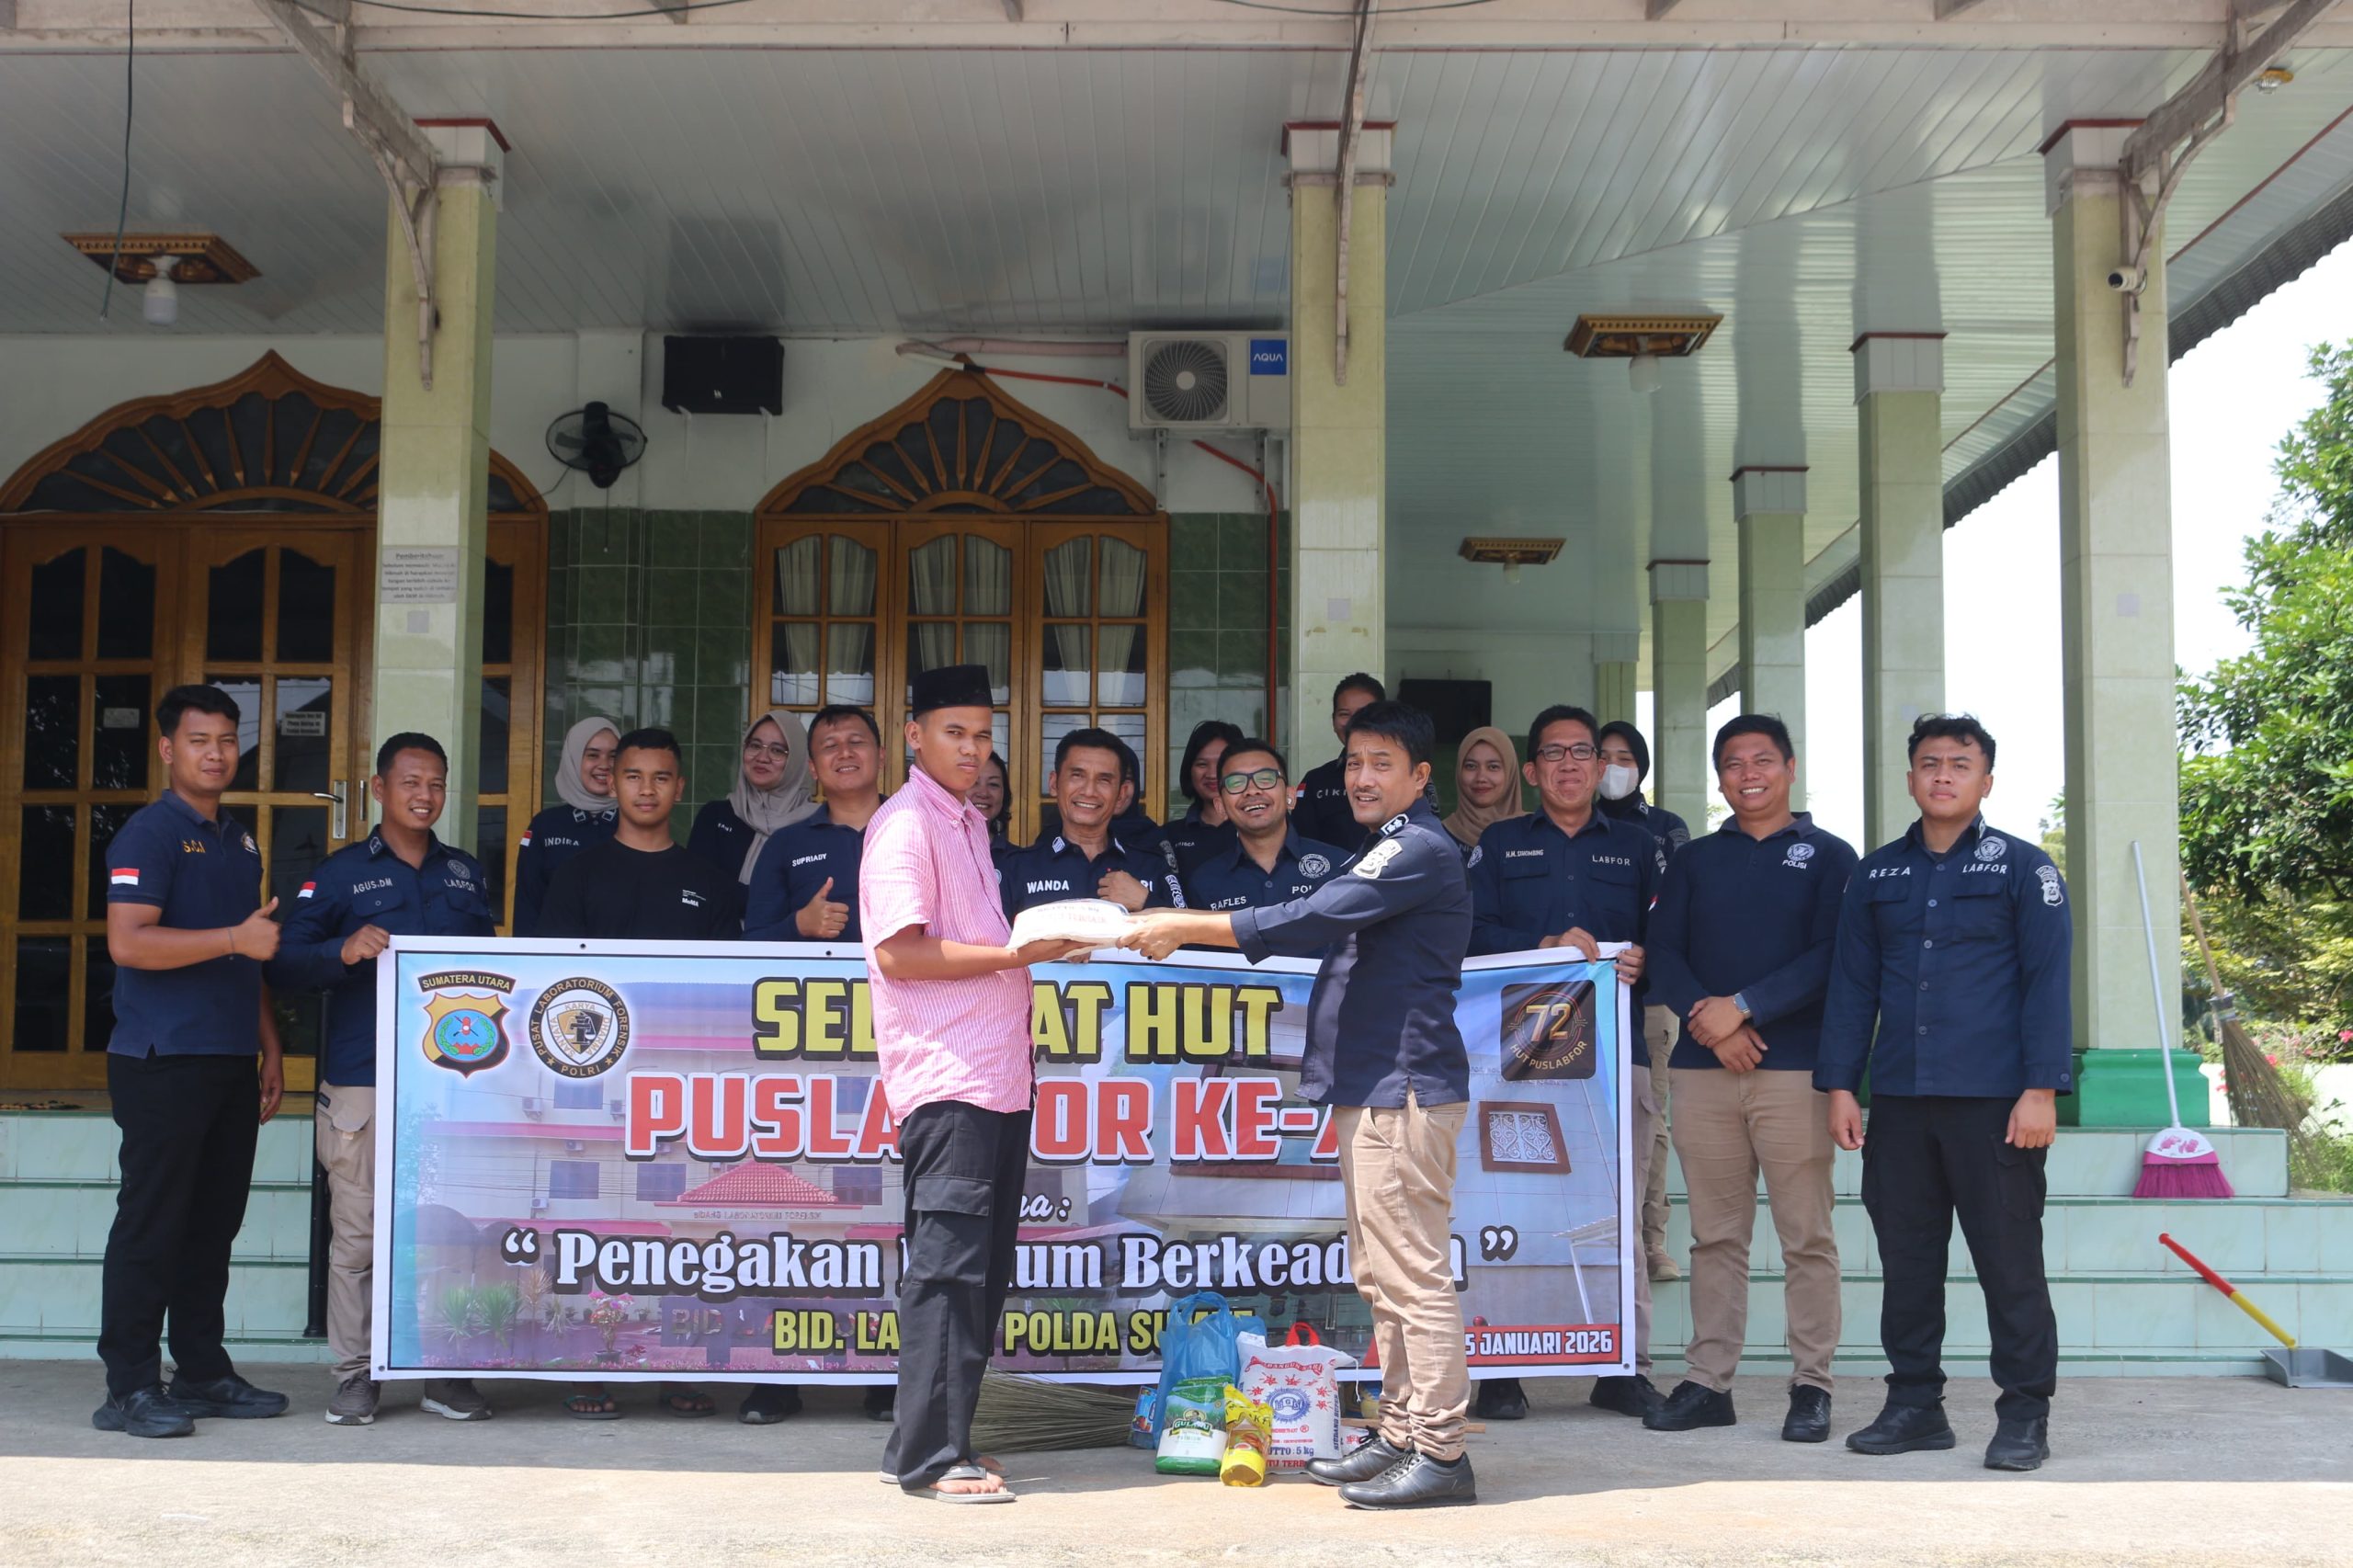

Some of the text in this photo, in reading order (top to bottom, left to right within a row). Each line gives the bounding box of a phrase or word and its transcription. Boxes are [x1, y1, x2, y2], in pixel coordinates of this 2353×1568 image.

[1253, 353, 1283, 361] AQUA
[791, 853, 827, 867] SUPRIADY
[1592, 855, 1631, 867] LABFOR
[1782, 859, 1807, 869] POLISI
[1869, 866, 1911, 880] REZA
[1961, 863, 2008, 875] LABFOR
[444, 878, 476, 893] LABFOR
[1027, 879, 1070, 894] WANDA
[1210, 895, 1247, 912] RAFLES
[422, 974, 511, 991] SUMATERA UTARA
[564, 1003, 596, 1012] KARYA
[531, 979, 628, 1058] PUSAT LABORATORIUM FORENSIK
[755, 980, 1281, 1057] SELAT HUT
[1527, 1003, 1572, 1042] 72
[1509, 1043, 1530, 1062] HUT
[1529, 1040, 1588, 1070] PUSLABFOR
[561, 1064, 600, 1076] POLRI
[627, 1072, 1154, 1161] PUSLAOR
[556, 1232, 881, 1294] Penegakan
[774, 1311, 845, 1349] BID.
[1004, 1312, 1120, 1352] POLDA
[1479, 1331, 1562, 1356] JANUARI
[1564, 1330, 1613, 1354] 2026
[1296, 1446, 1302, 1455] 5
[1303, 1446, 1314, 1457] kg
